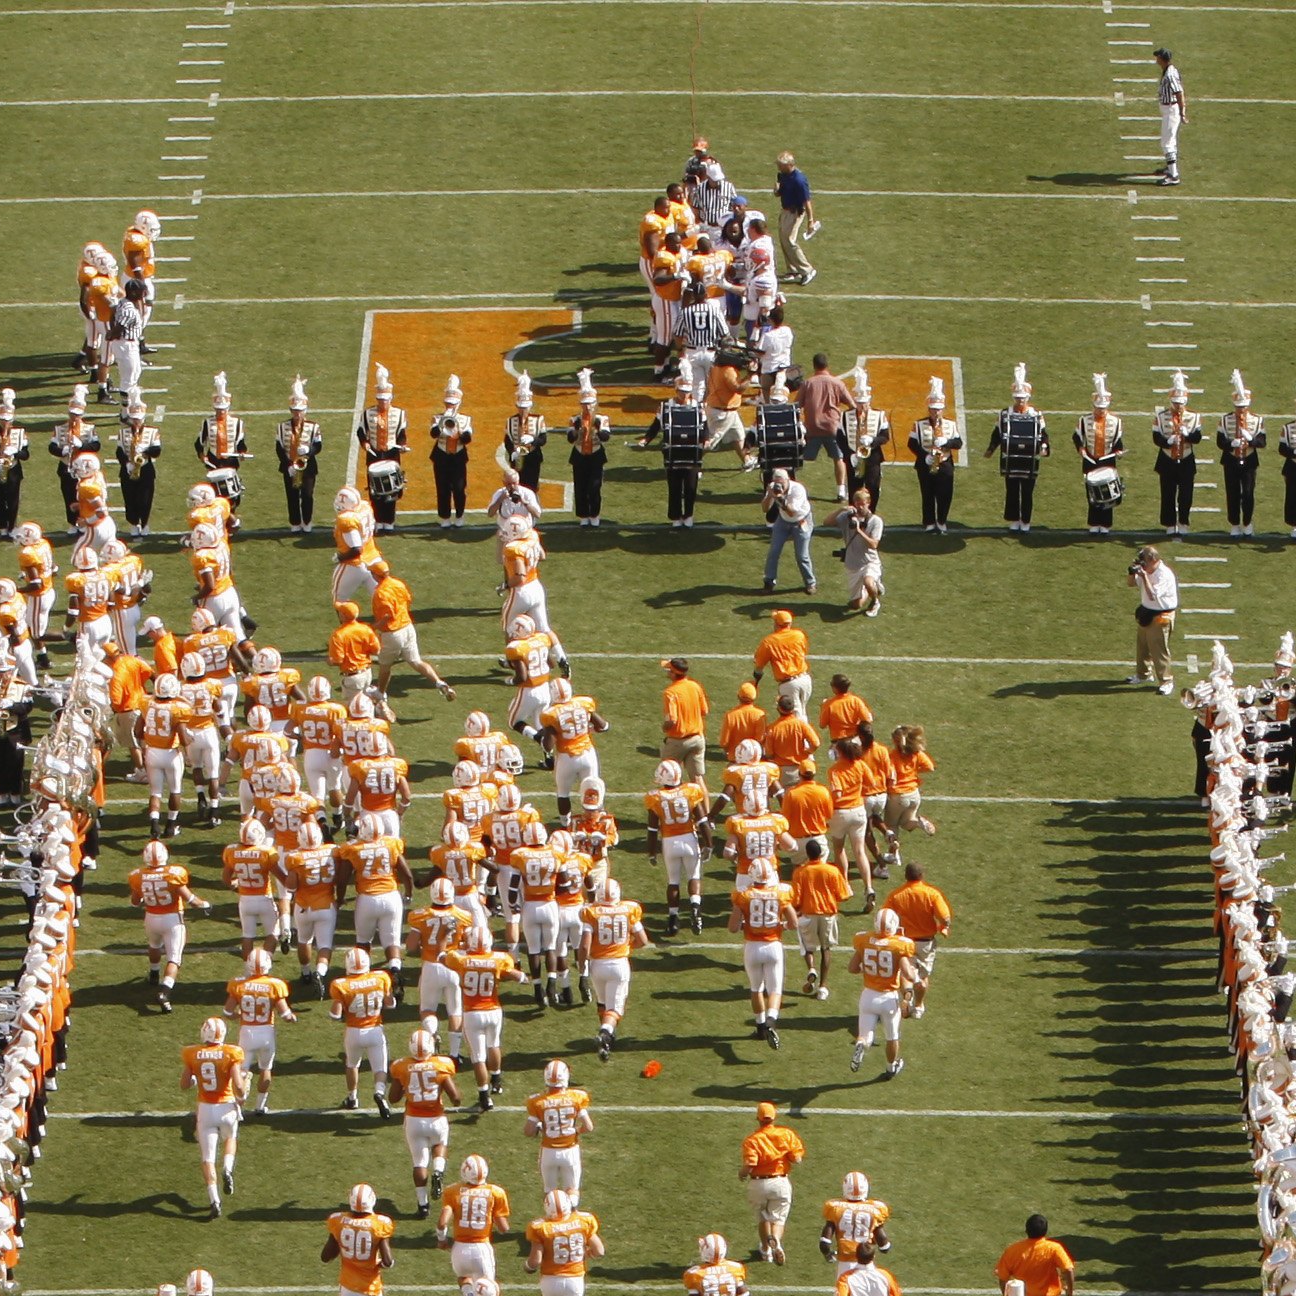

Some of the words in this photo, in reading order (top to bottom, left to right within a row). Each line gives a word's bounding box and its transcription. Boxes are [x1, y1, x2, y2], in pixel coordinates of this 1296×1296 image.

[694, 311, 708, 330] U
[303, 720, 330, 746] 23
[365, 768, 396, 794] 40
[660, 796, 691, 825] 19
[233, 863, 264, 888] 25
[597, 914, 629, 945] 60
[863, 948, 893, 978] 59
[463, 970, 495, 998] 90
[240, 995, 271, 1023] 93
[348, 989, 384, 1018] 40
[200, 1061, 218, 1092] 9
[407, 1070, 440, 1103] 45
[458, 1196, 489, 1230] 18
[340, 1227, 373, 1261] 90
